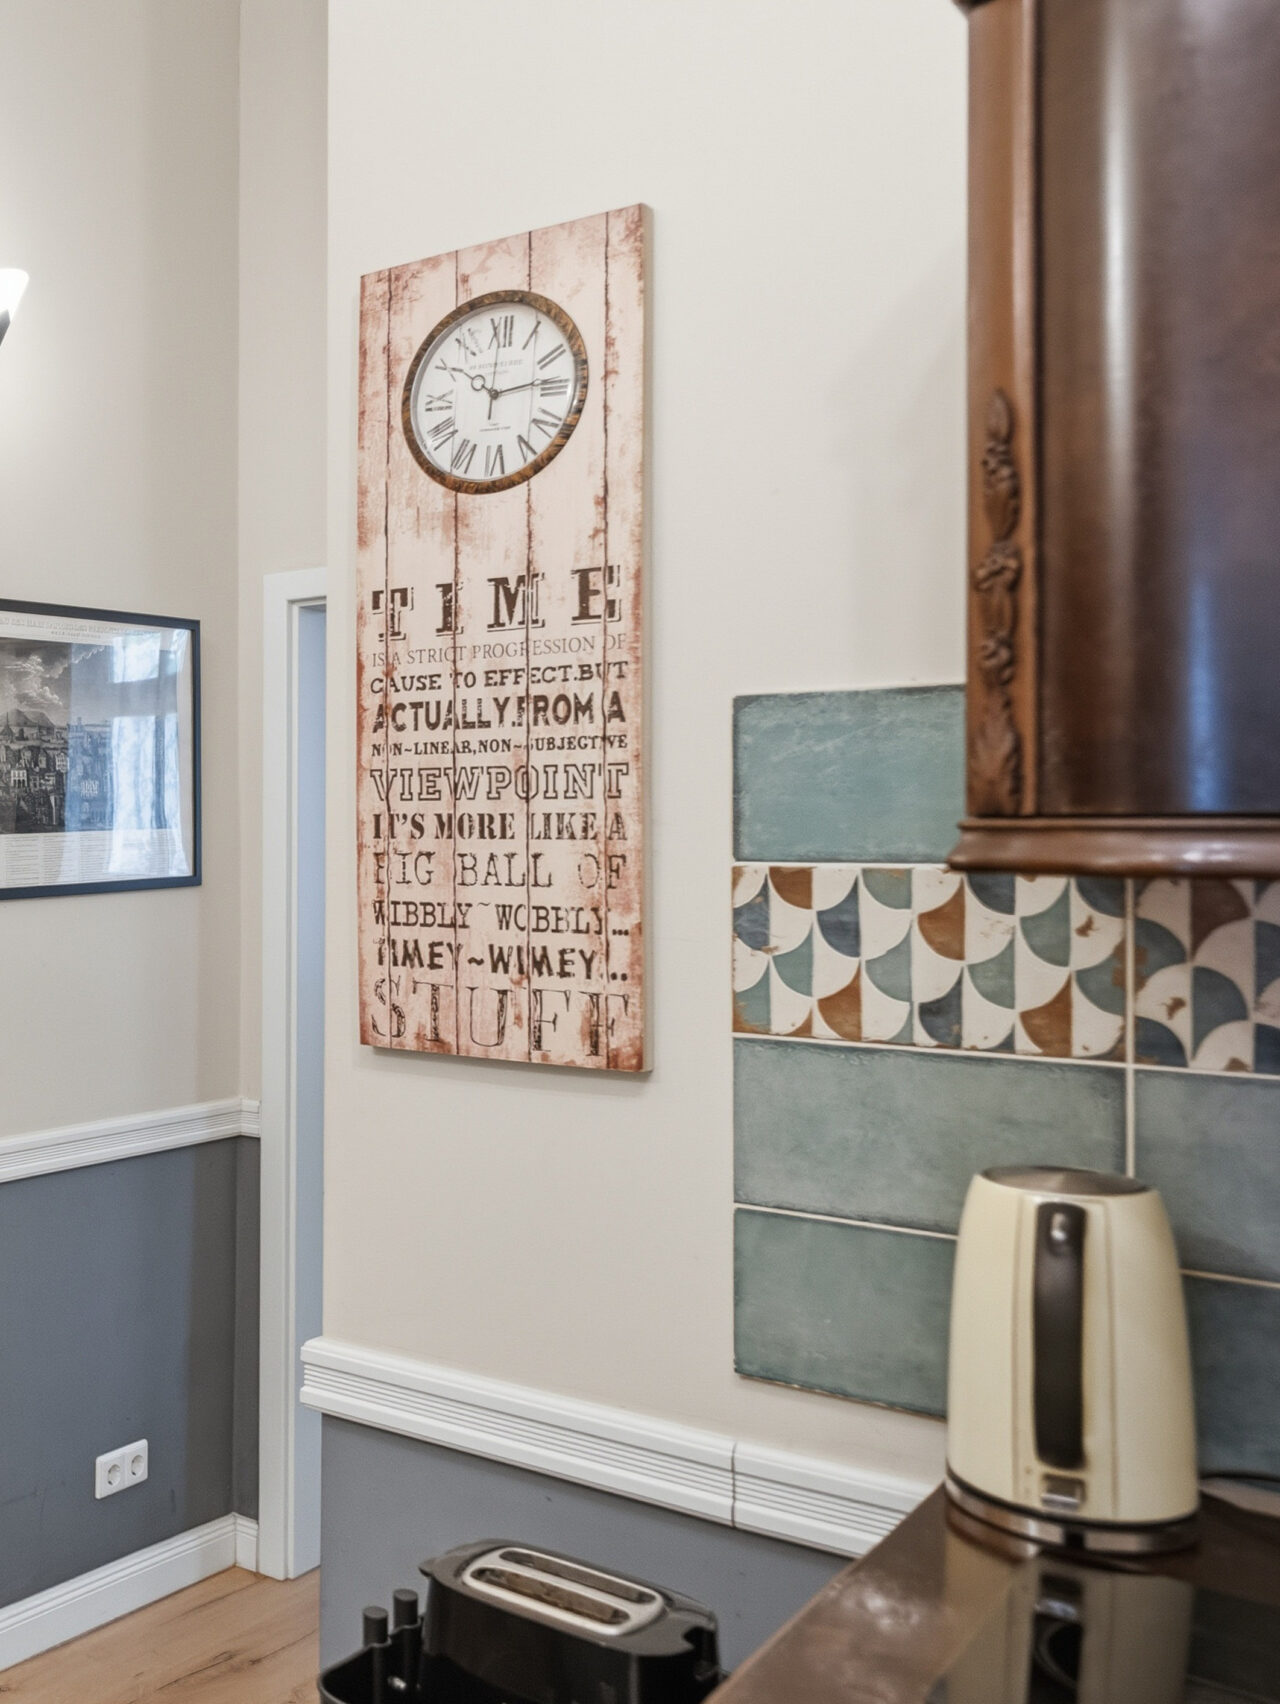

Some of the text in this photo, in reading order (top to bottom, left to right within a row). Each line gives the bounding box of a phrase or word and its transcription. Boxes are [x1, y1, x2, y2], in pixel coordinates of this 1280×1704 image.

[371, 564, 623, 642] TIME
[372, 633, 627, 667] IS A STRICT PROGRESSION OF
[370, 673, 442, 694] CAUSE
[449, 671, 477, 689] TO
[607, 690, 626, 723] A
[370, 762, 629, 802] VIEWPOINT
[372, 810, 628, 840] IT'S MORE LIKE A
[373, 851, 627, 890] BIG BALL OF
[371, 976, 629, 1057] STUFF
